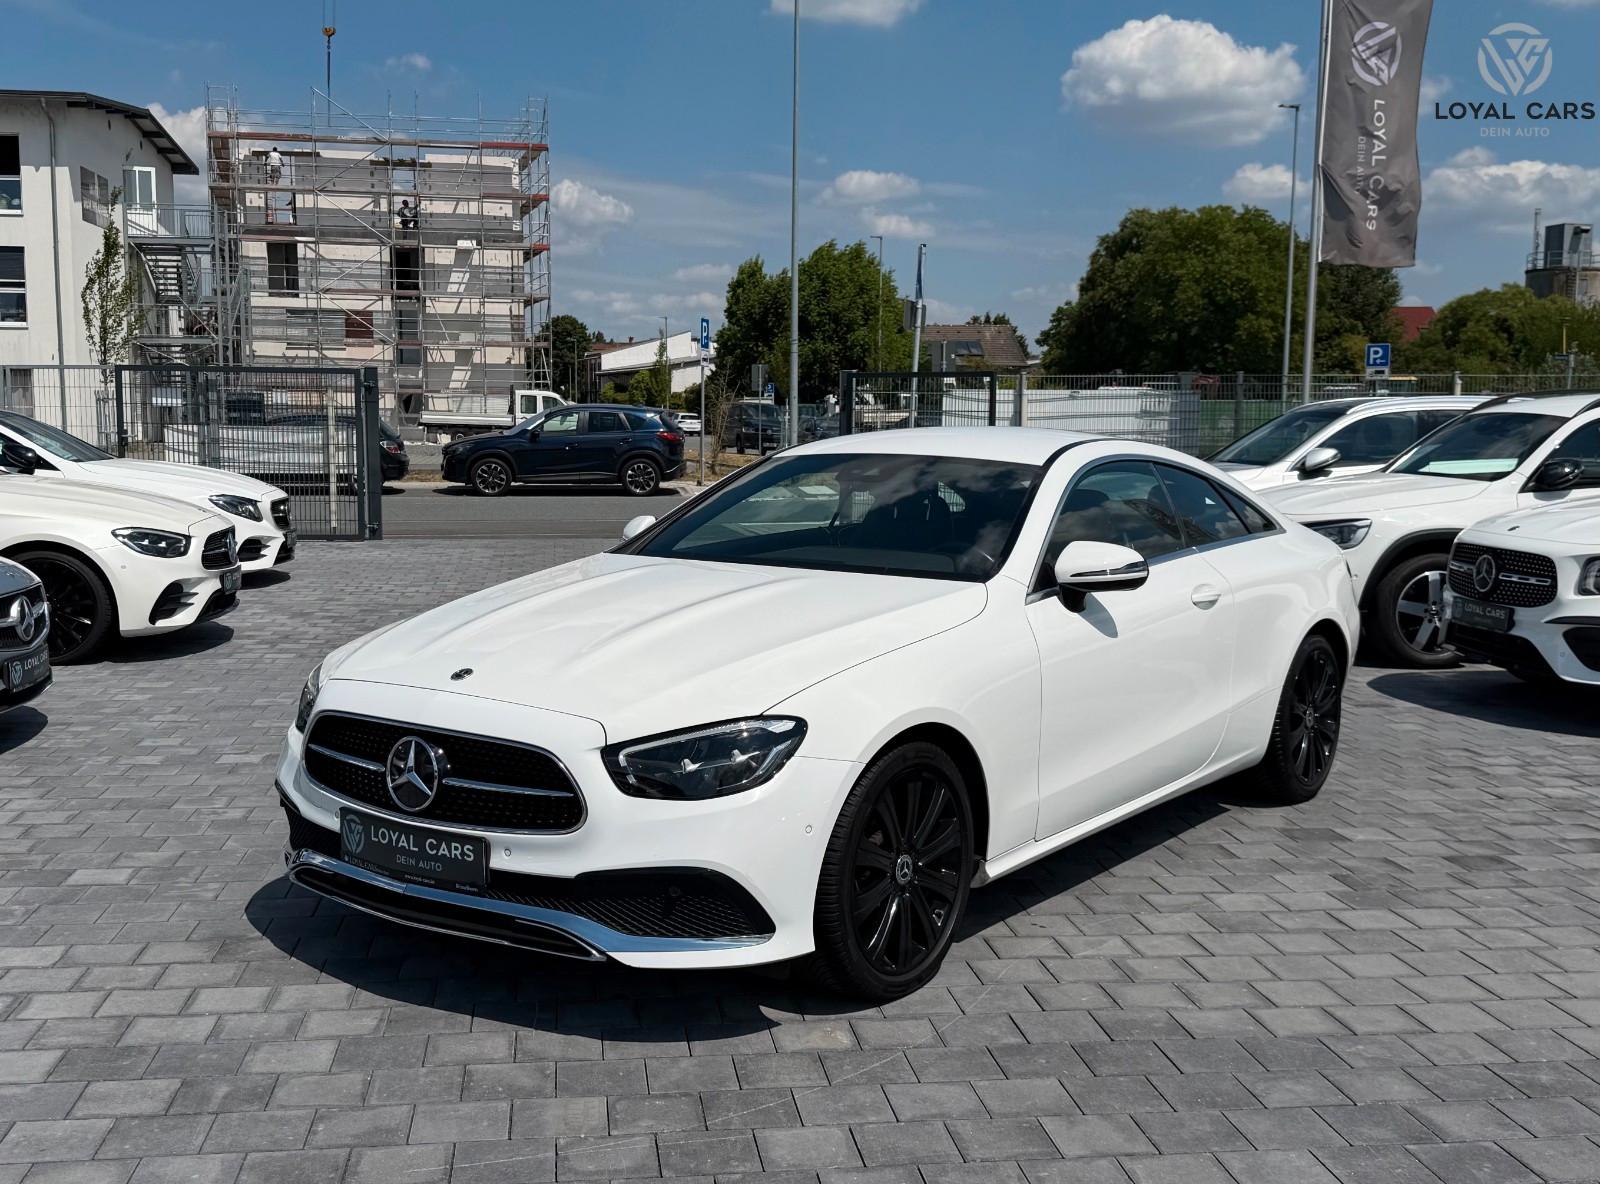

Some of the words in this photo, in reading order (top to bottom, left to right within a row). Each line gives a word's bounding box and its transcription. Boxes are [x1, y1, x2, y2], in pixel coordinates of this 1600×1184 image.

[1371, 99, 1387, 167] LOYAL
[1357, 136, 1366, 162] DEIN
[702, 321, 708, 345] P
[1369, 347, 1383, 365] P
[371, 825, 419, 852] LOYAL
[425, 838, 475, 862] CARS
[396, 853, 416, 867] DEIN
[418, 859, 443, 872] AUTO
